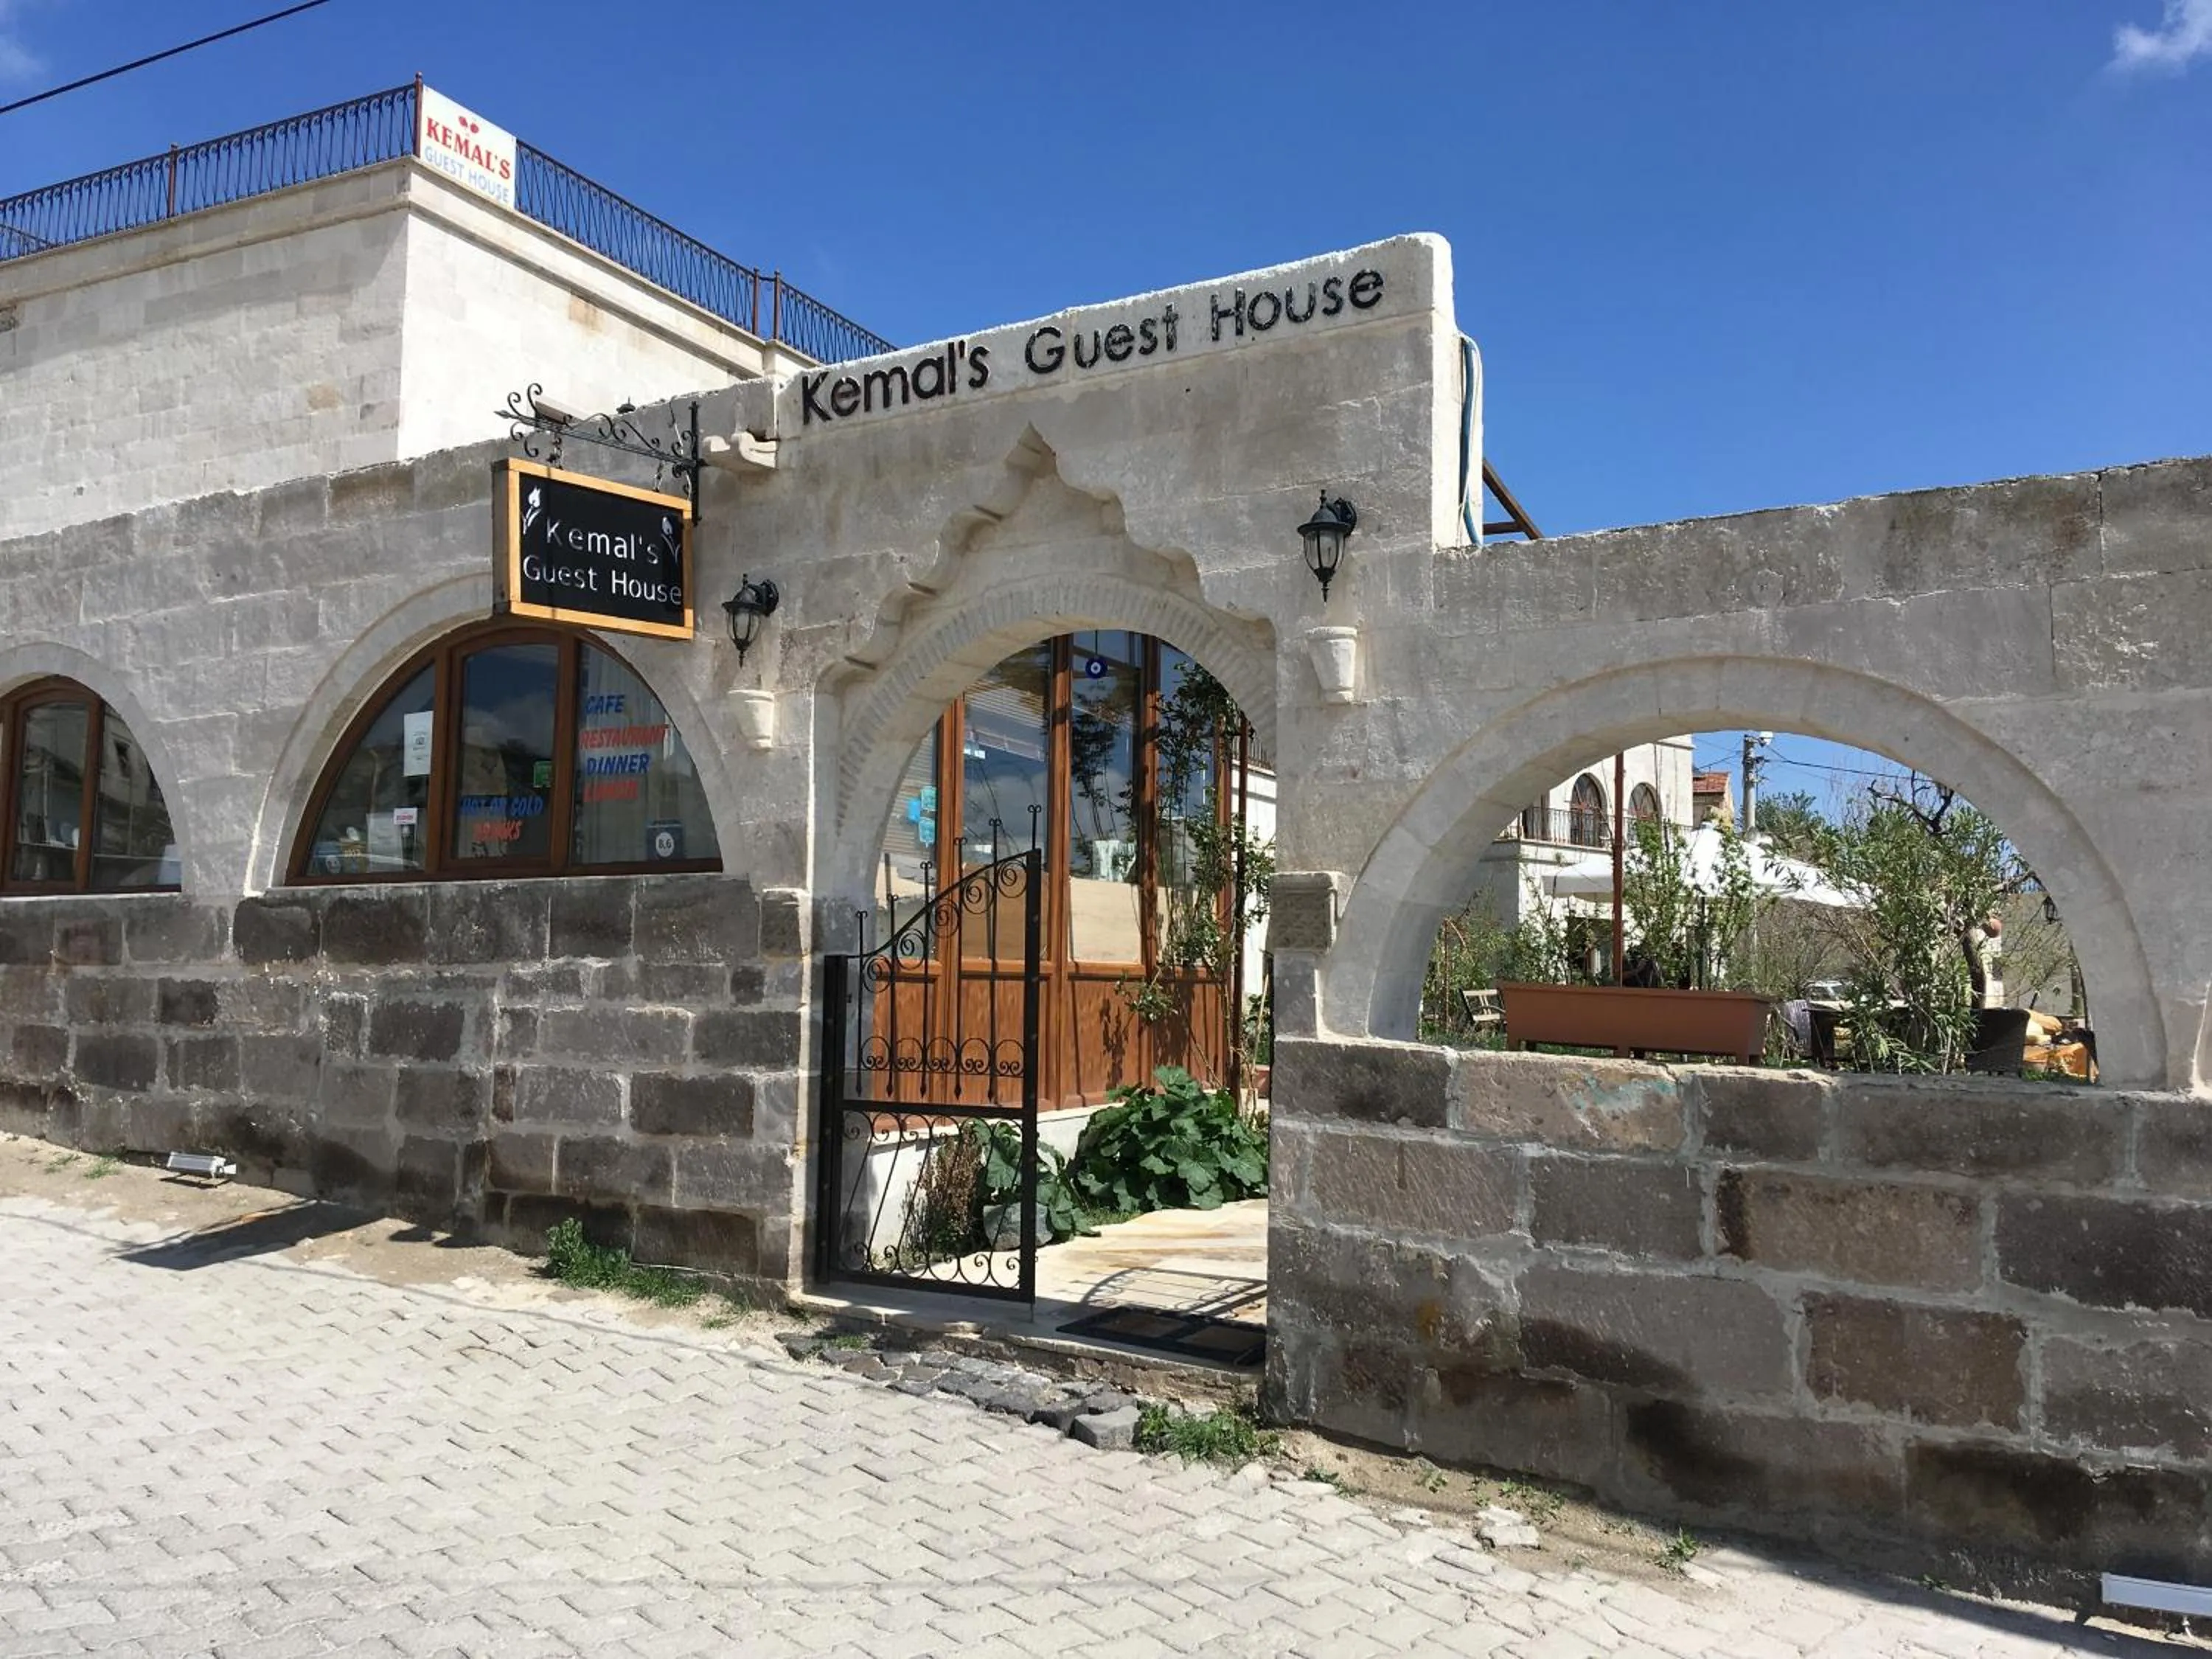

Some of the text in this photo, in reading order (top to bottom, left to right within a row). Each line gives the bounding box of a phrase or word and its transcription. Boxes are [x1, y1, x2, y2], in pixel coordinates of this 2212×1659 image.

[425, 116, 511, 180] KEMAL'S
[424, 145, 509, 204] GUEST HOUSE
[801, 268, 1385, 425] Kemal's Guest House
[545, 517, 659, 565] Kemal's
[523, 554, 683, 605] Guest House
[585, 694, 625, 714] CAFE
[586, 753, 651, 776] DINNER
